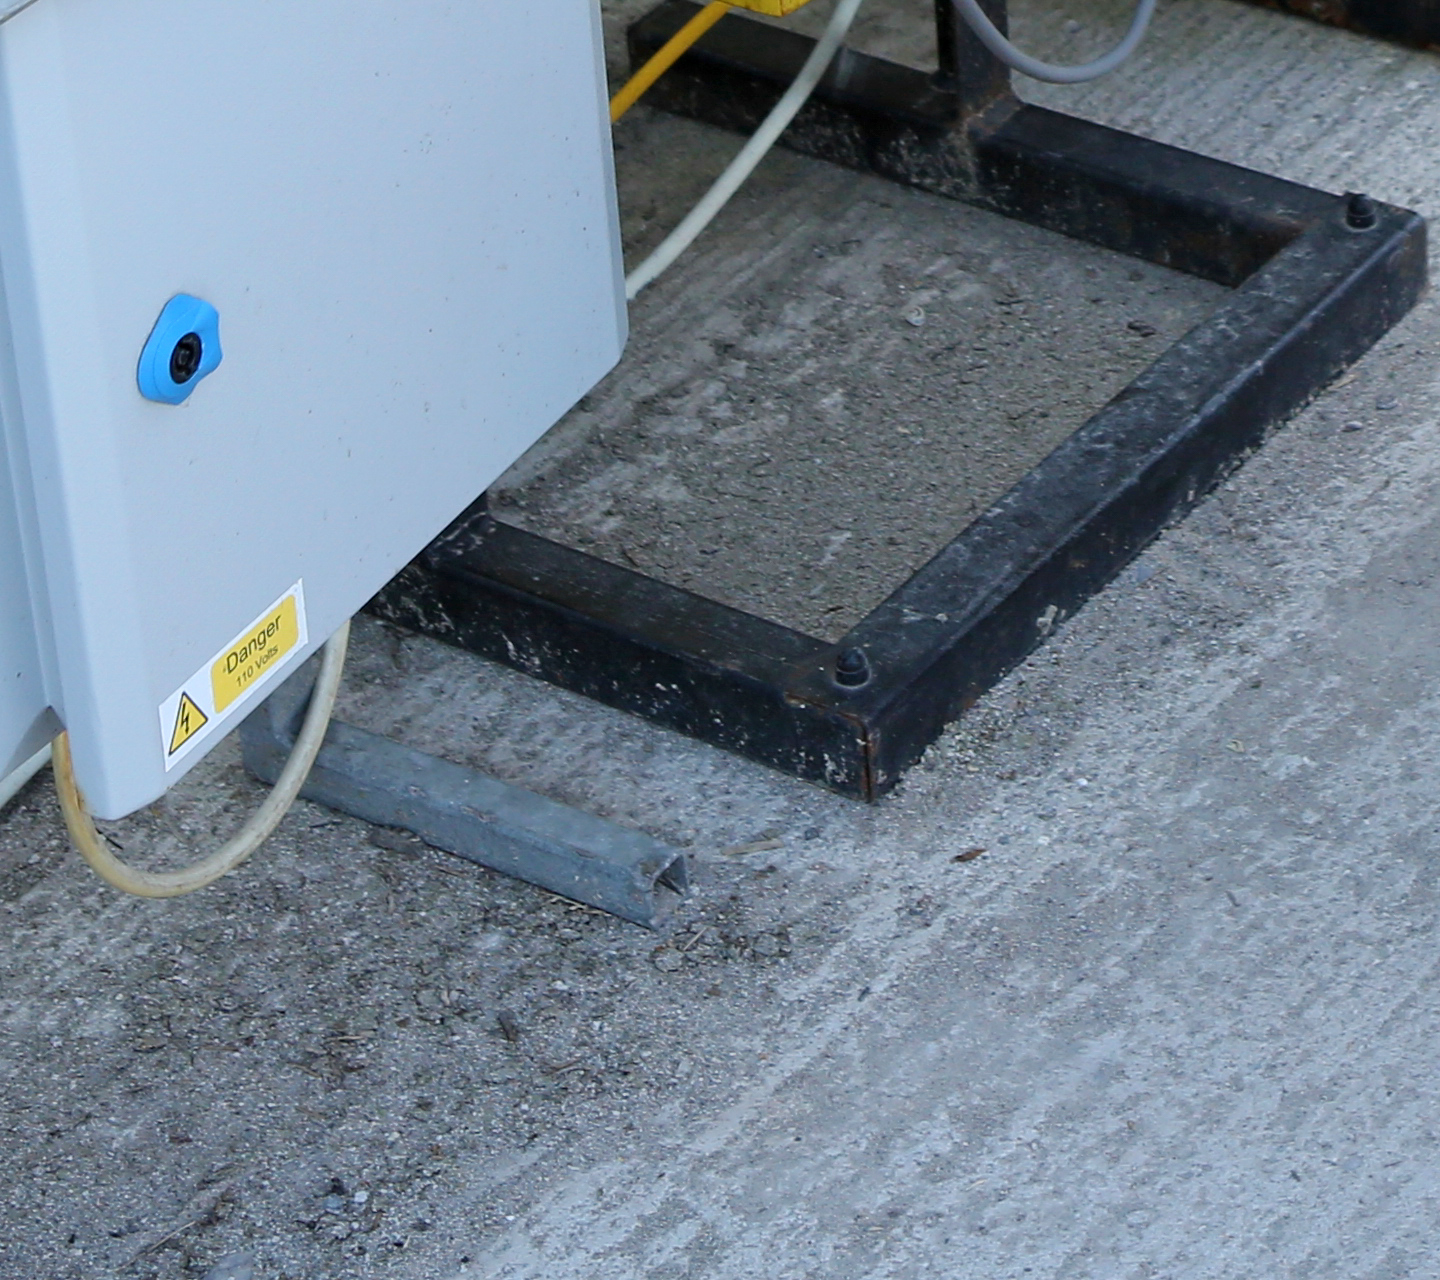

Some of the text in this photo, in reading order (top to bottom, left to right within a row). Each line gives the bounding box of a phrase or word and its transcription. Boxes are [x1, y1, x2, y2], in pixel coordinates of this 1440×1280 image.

[226, 614, 282, 675] Danger
[235, 644, 279, 687] 110 Volts
